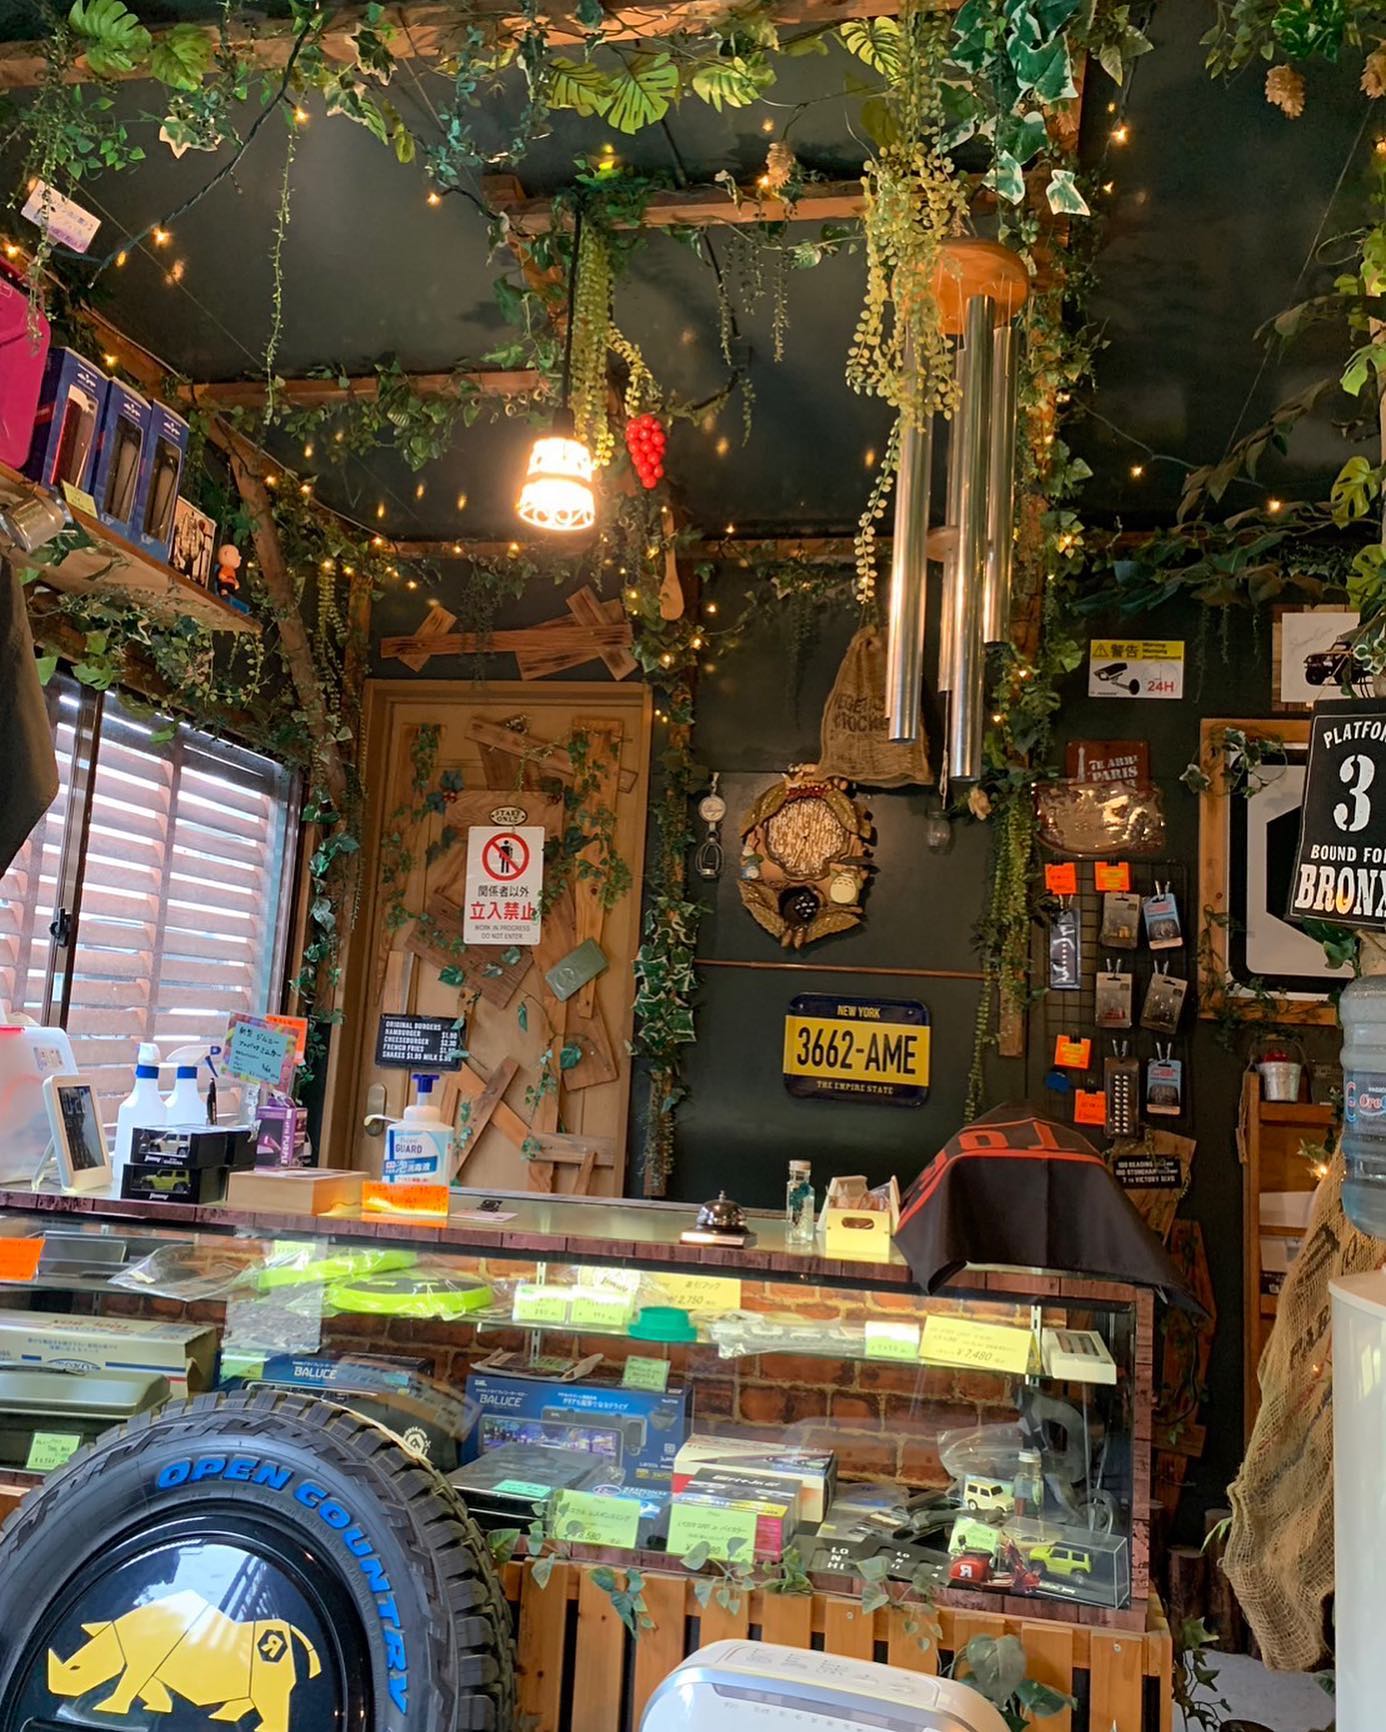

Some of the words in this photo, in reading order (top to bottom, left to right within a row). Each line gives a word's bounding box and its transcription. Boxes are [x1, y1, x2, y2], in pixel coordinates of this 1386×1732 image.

[1147, 680, 1175, 693] 24H
[1091, 766, 1139, 782] PARIS
[1332, 753, 1377, 833] 3
[1309, 844, 1358, 863] BOUND
[478, 885, 530, 898] 関係者以外
[470, 901, 536, 921] 立入禁止
[837, 1005, 857, 1017] NEW
[858, 1007, 881, 1019] YORK
[797, 1027, 918, 1075] 3662-AME
[817, 1080, 832, 1089] THE
[834, 1082, 864, 1093] EMPIRE
[866, 1085, 894, 1095] STATE
[395, 1143, 423, 1154] GUARD
[293, 1365, 338, 1380] BALUCE
[479, 1393, 523, 1408] BALUCE
[157, 1455, 295, 1491] OPEN
[294, 1479, 409, 1716] COUNTRY
